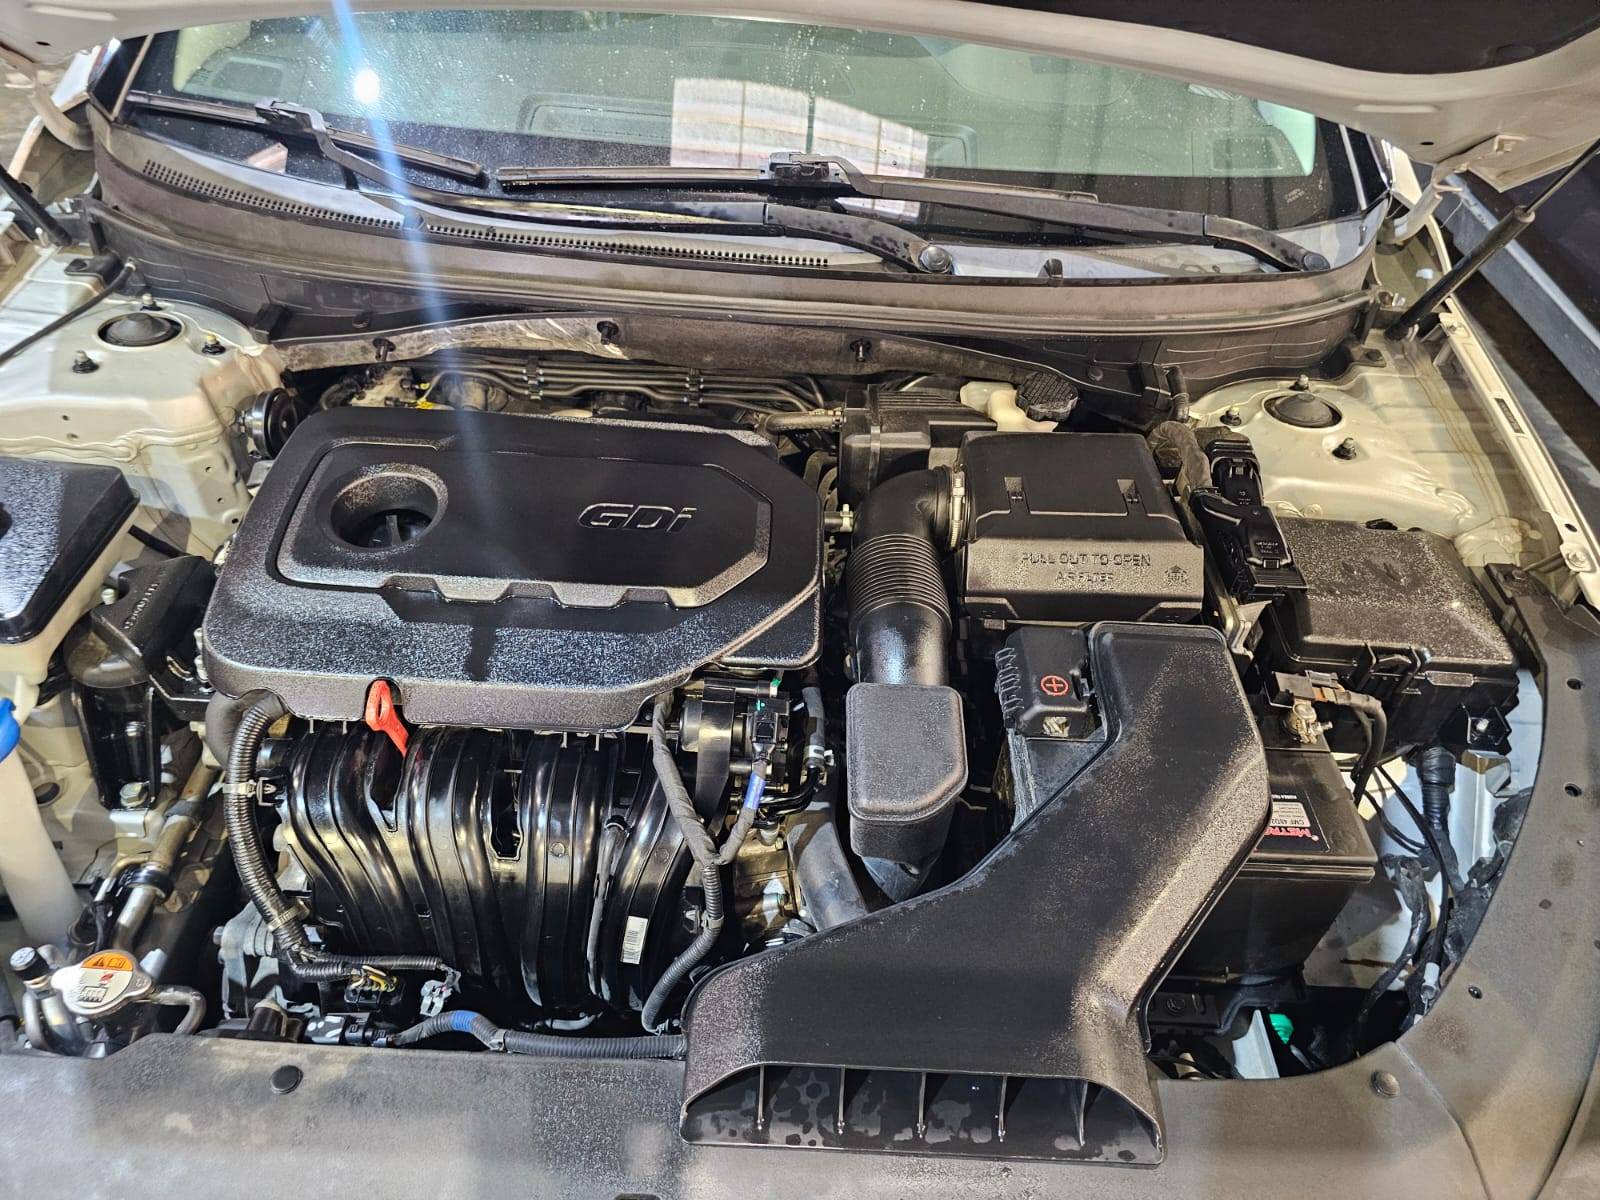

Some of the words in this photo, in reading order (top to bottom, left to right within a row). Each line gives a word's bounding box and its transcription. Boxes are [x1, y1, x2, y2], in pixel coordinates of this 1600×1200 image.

[1021, 552, 1055, 565] PULL
[1059, 552, 1089, 566] OUT
[1091, 553, 1109, 566] TO
[1113, 553, 1151, 567] OPEN
[1055, 570, 1075, 582] AR
[1078, 570, 1114, 583] FLTER
